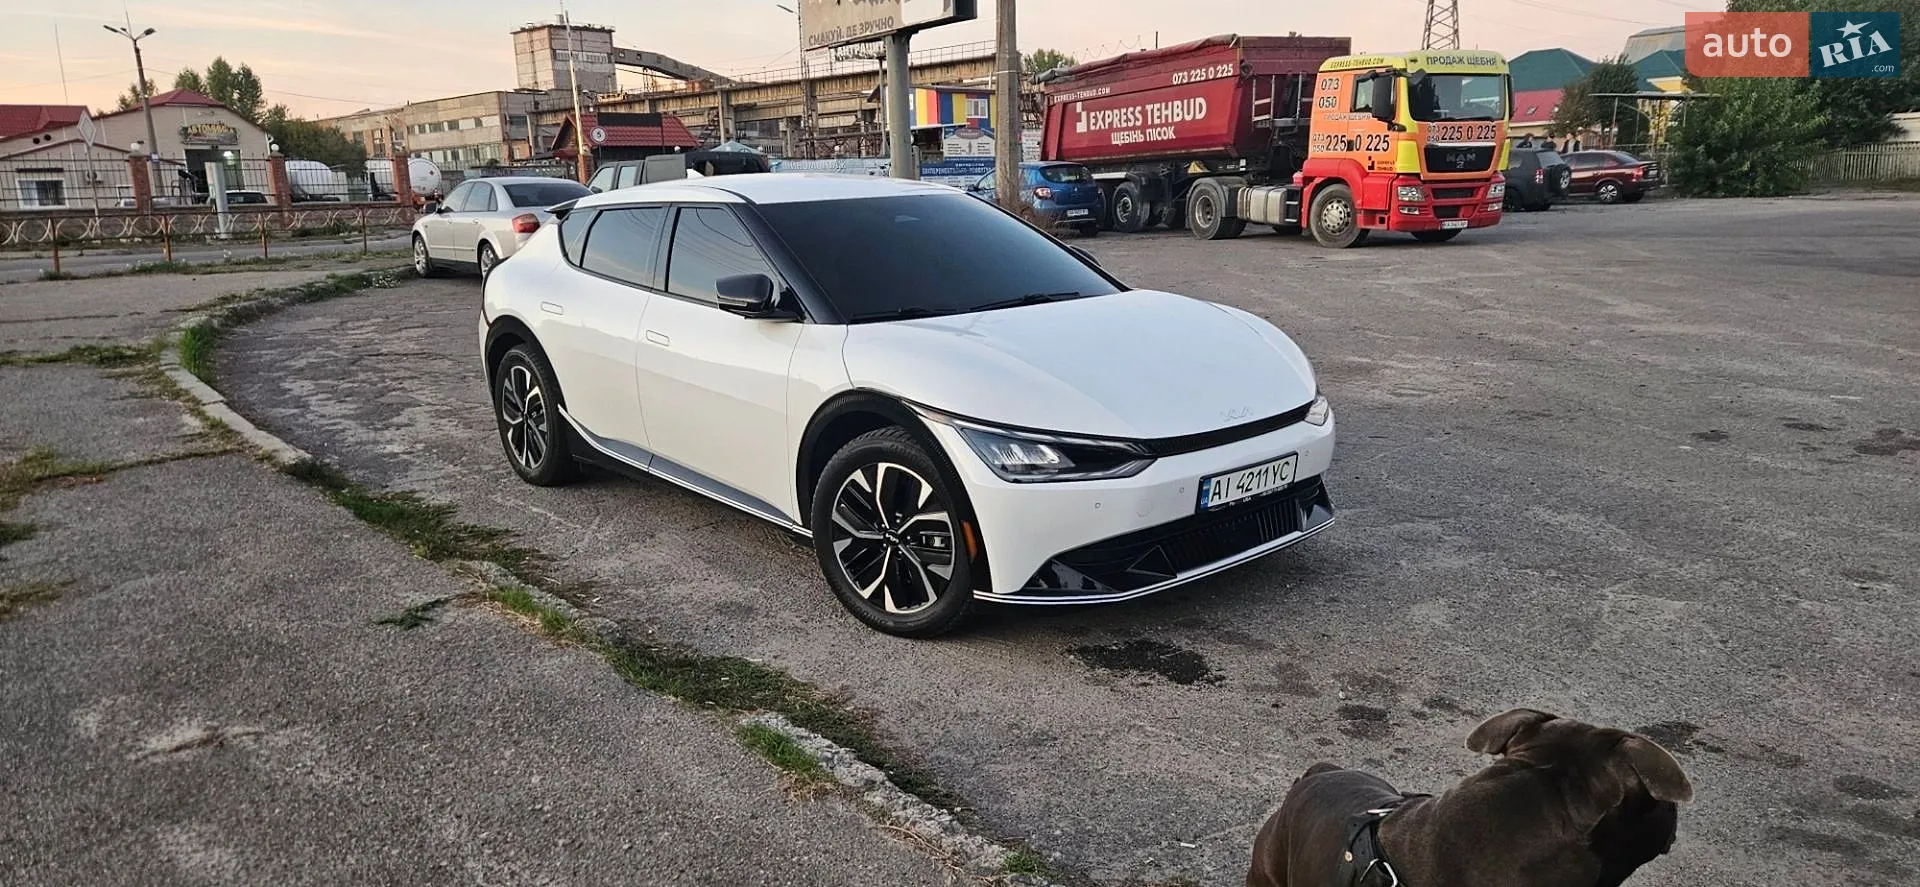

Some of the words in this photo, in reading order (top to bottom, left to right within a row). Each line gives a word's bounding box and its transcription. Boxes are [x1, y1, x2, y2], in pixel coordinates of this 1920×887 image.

[846, 25, 857, 38] ДЕ
[859, 15, 894, 35] ЗРУЧНО
[1426, 55, 1465, 65] ПРОДАЖ
[1467, 54, 1497, 65] ЩЕБНЯ
[1173, 72, 1188, 85] 073
[1190, 68, 1206, 82] 225
[1208, 67, 1214, 79] 0
[1216, 64, 1233, 78] 225
[1320, 78, 1339, 90] 073
[1318, 96, 1337, 109] 050
[1089, 105, 1143, 131] EXPRESS
[1145, 97, 1207, 125] TEHBUD
[1111, 130, 1145, 146] ЩЕБІНЬ
[1146, 126, 1176, 142] ПІСОК
[1441, 126, 1462, 141] 225
[1466, 125, 1473, 140] 0
[1477, 125, 1496, 139] 225
[1325, 134, 1347, 152] 225
[1354, 134, 1361, 152] 0
[1366, 134, 1390, 152] 225
[1210, 477, 1231, 502] AI
[1236, 466, 1270, 494] 4211
[1271, 461, 1290, 485] YC
